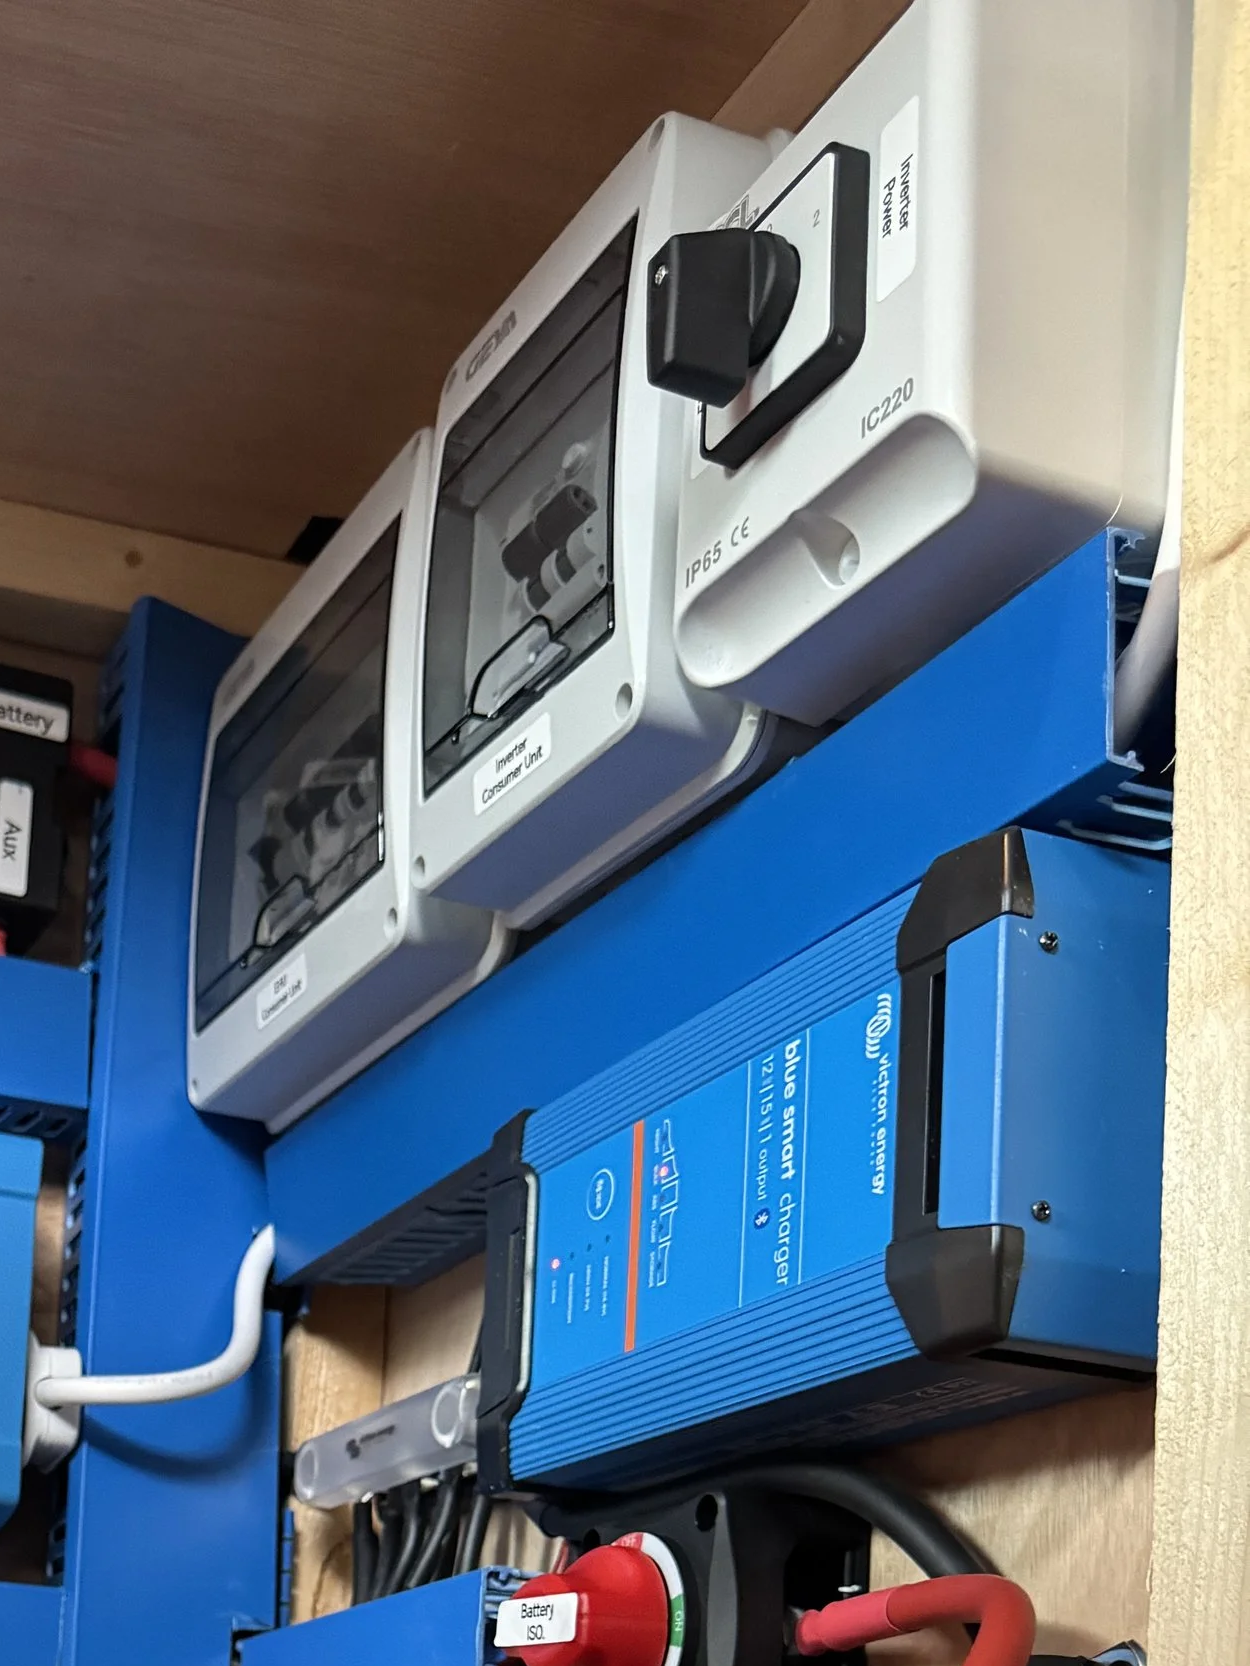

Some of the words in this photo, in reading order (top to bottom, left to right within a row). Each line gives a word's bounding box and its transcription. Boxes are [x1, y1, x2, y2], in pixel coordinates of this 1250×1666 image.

[882, 176, 896, 238] Power
[899, 153, 914, 231] Inverter
[861, 377, 914, 439] IC220
[686, 540, 722, 589] IP65
[482, 763, 523, 804] Consumer
[524, 745, 543, 768] Unit
[495, 738, 527, 774] Inverter
[2, 819, 23, 861] Aux
[783, 1038, 802, 1099] blue
[878, 1053, 892, 1123] victron
[780, 1106, 796, 1180] smart
[871, 1127, 886, 1195] energy
[755, 1148, 768, 1201] output
[774, 1192, 797, 1286] charger
[520, 1603, 554, 1621] Battery
[526, 1625, 545, 1641] ISO.
[675, 1610, 683, 1632] ON
